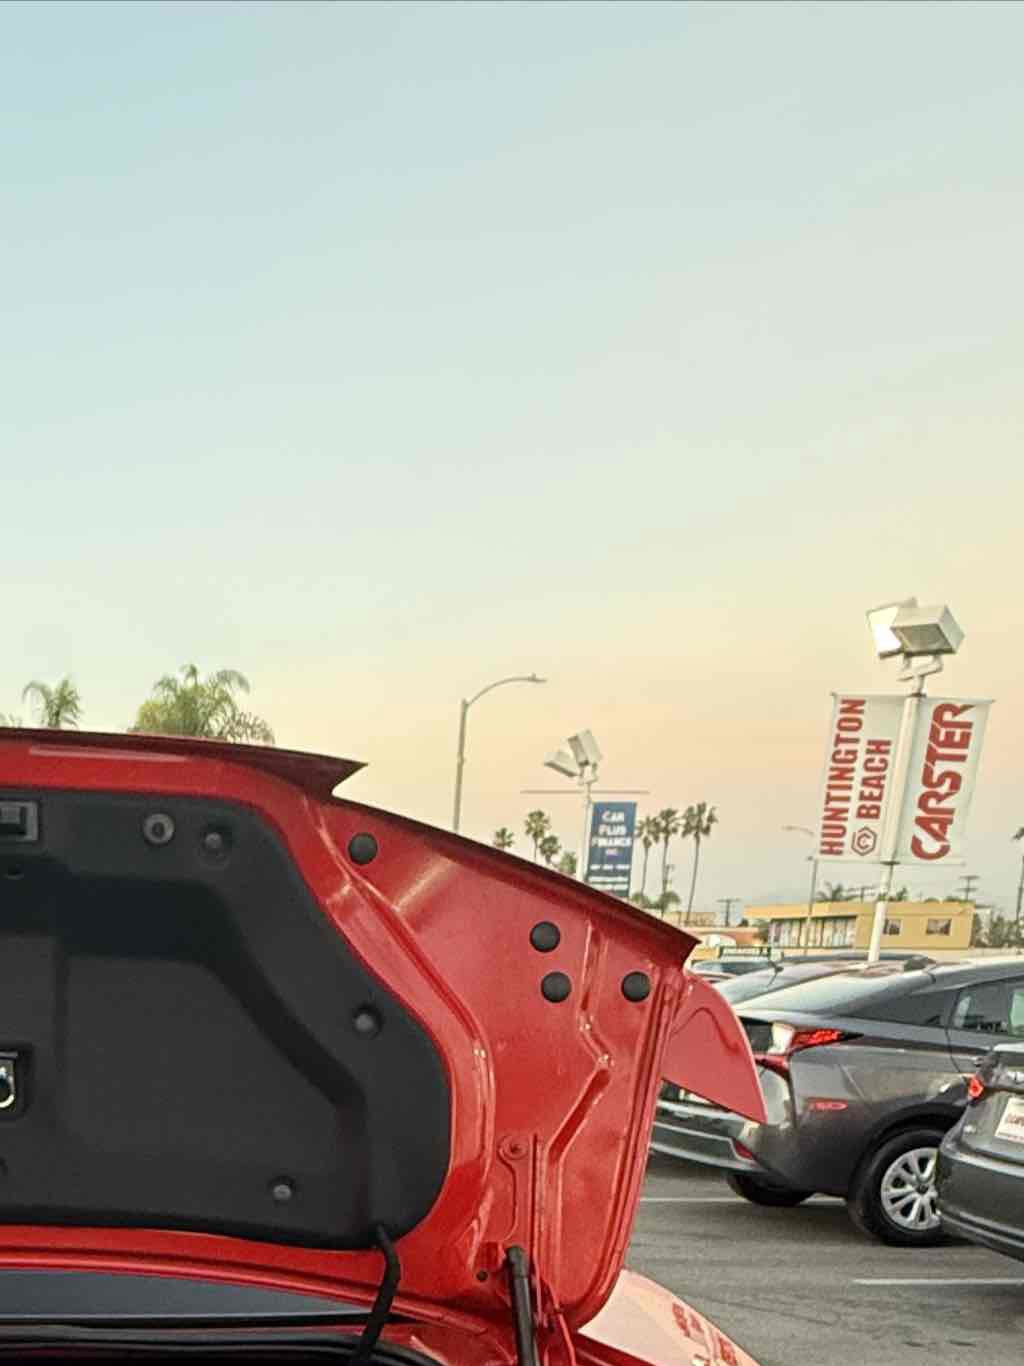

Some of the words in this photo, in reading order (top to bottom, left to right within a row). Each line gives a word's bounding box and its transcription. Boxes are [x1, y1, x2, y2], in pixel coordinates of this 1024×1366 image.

[820, 699, 866, 855] HUNTINGTON
[856, 739, 892, 819] BEACH
[911, 702, 975, 860] CARSTER
